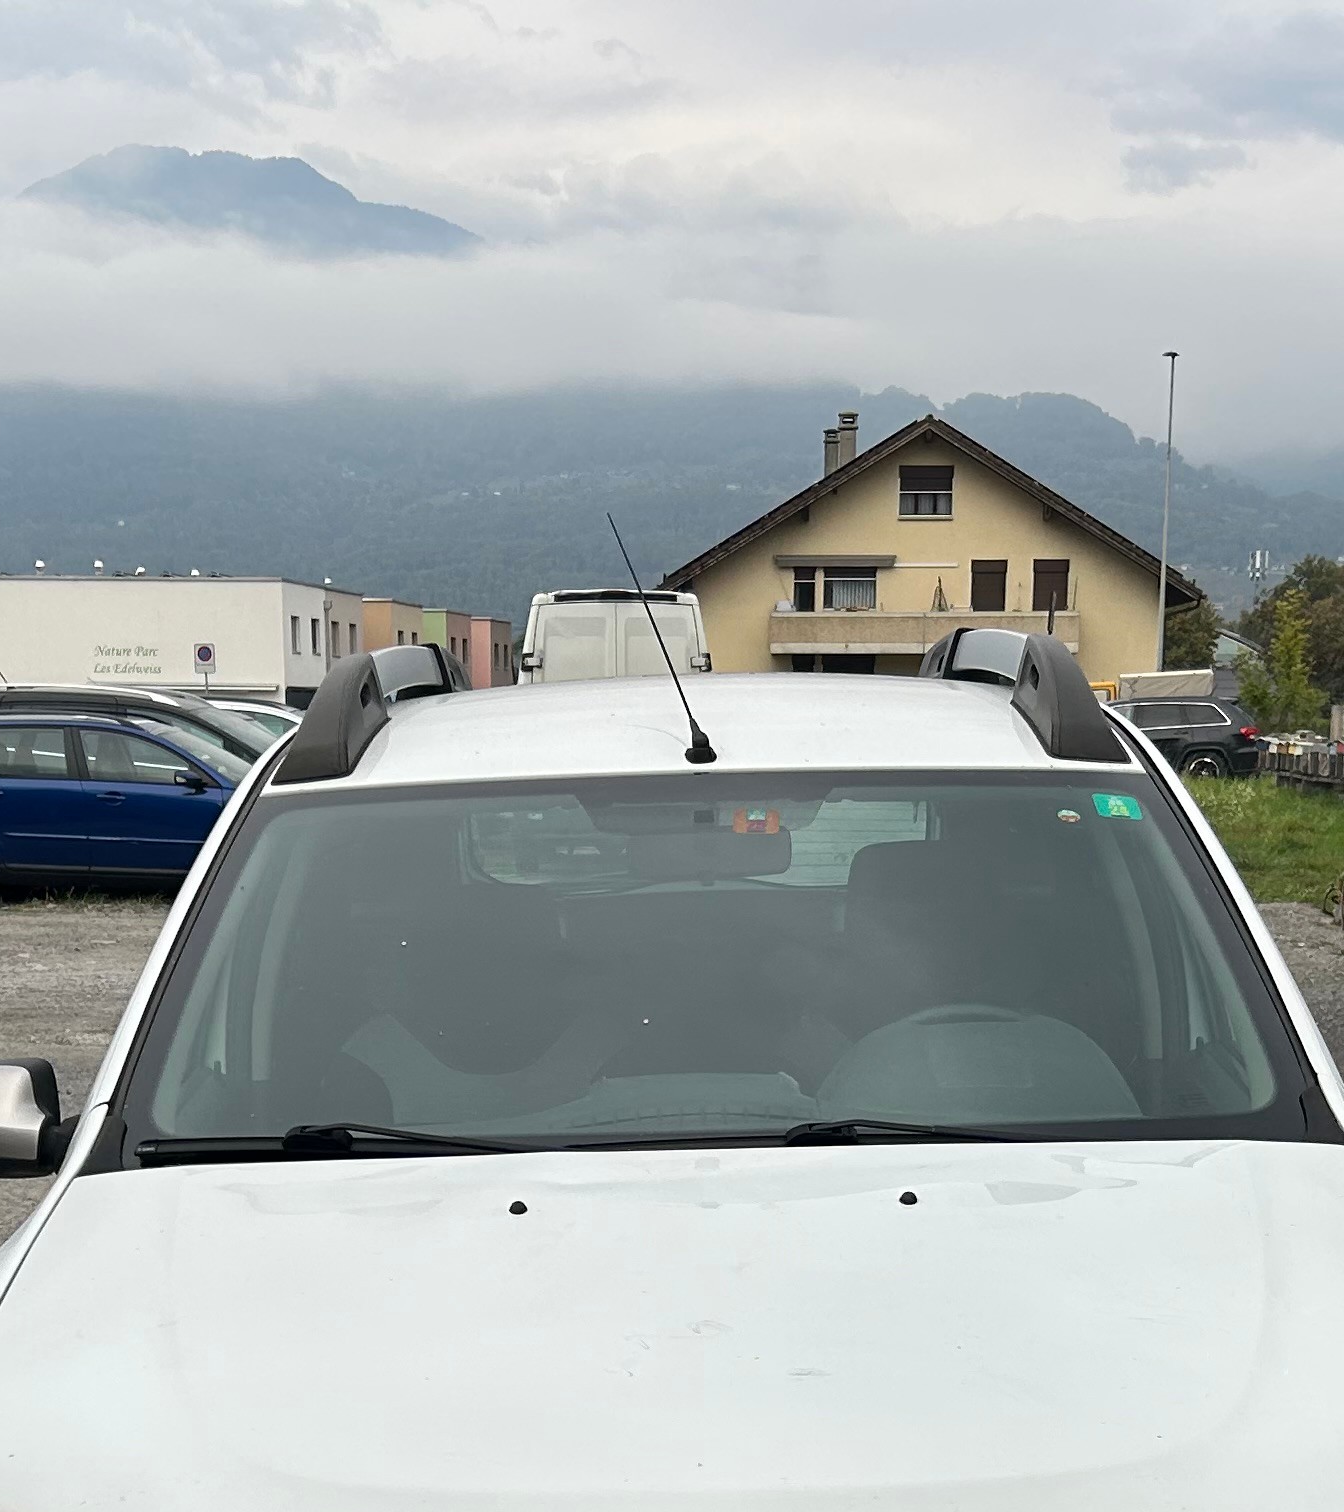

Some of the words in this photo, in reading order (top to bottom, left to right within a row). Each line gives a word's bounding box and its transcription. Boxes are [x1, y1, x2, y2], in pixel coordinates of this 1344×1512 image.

[94, 645, 132, 657] Nature
[134, 645, 159, 657] Parc
[93, 662, 111, 674] Les
[112, 661, 162, 674] Edelweiss
